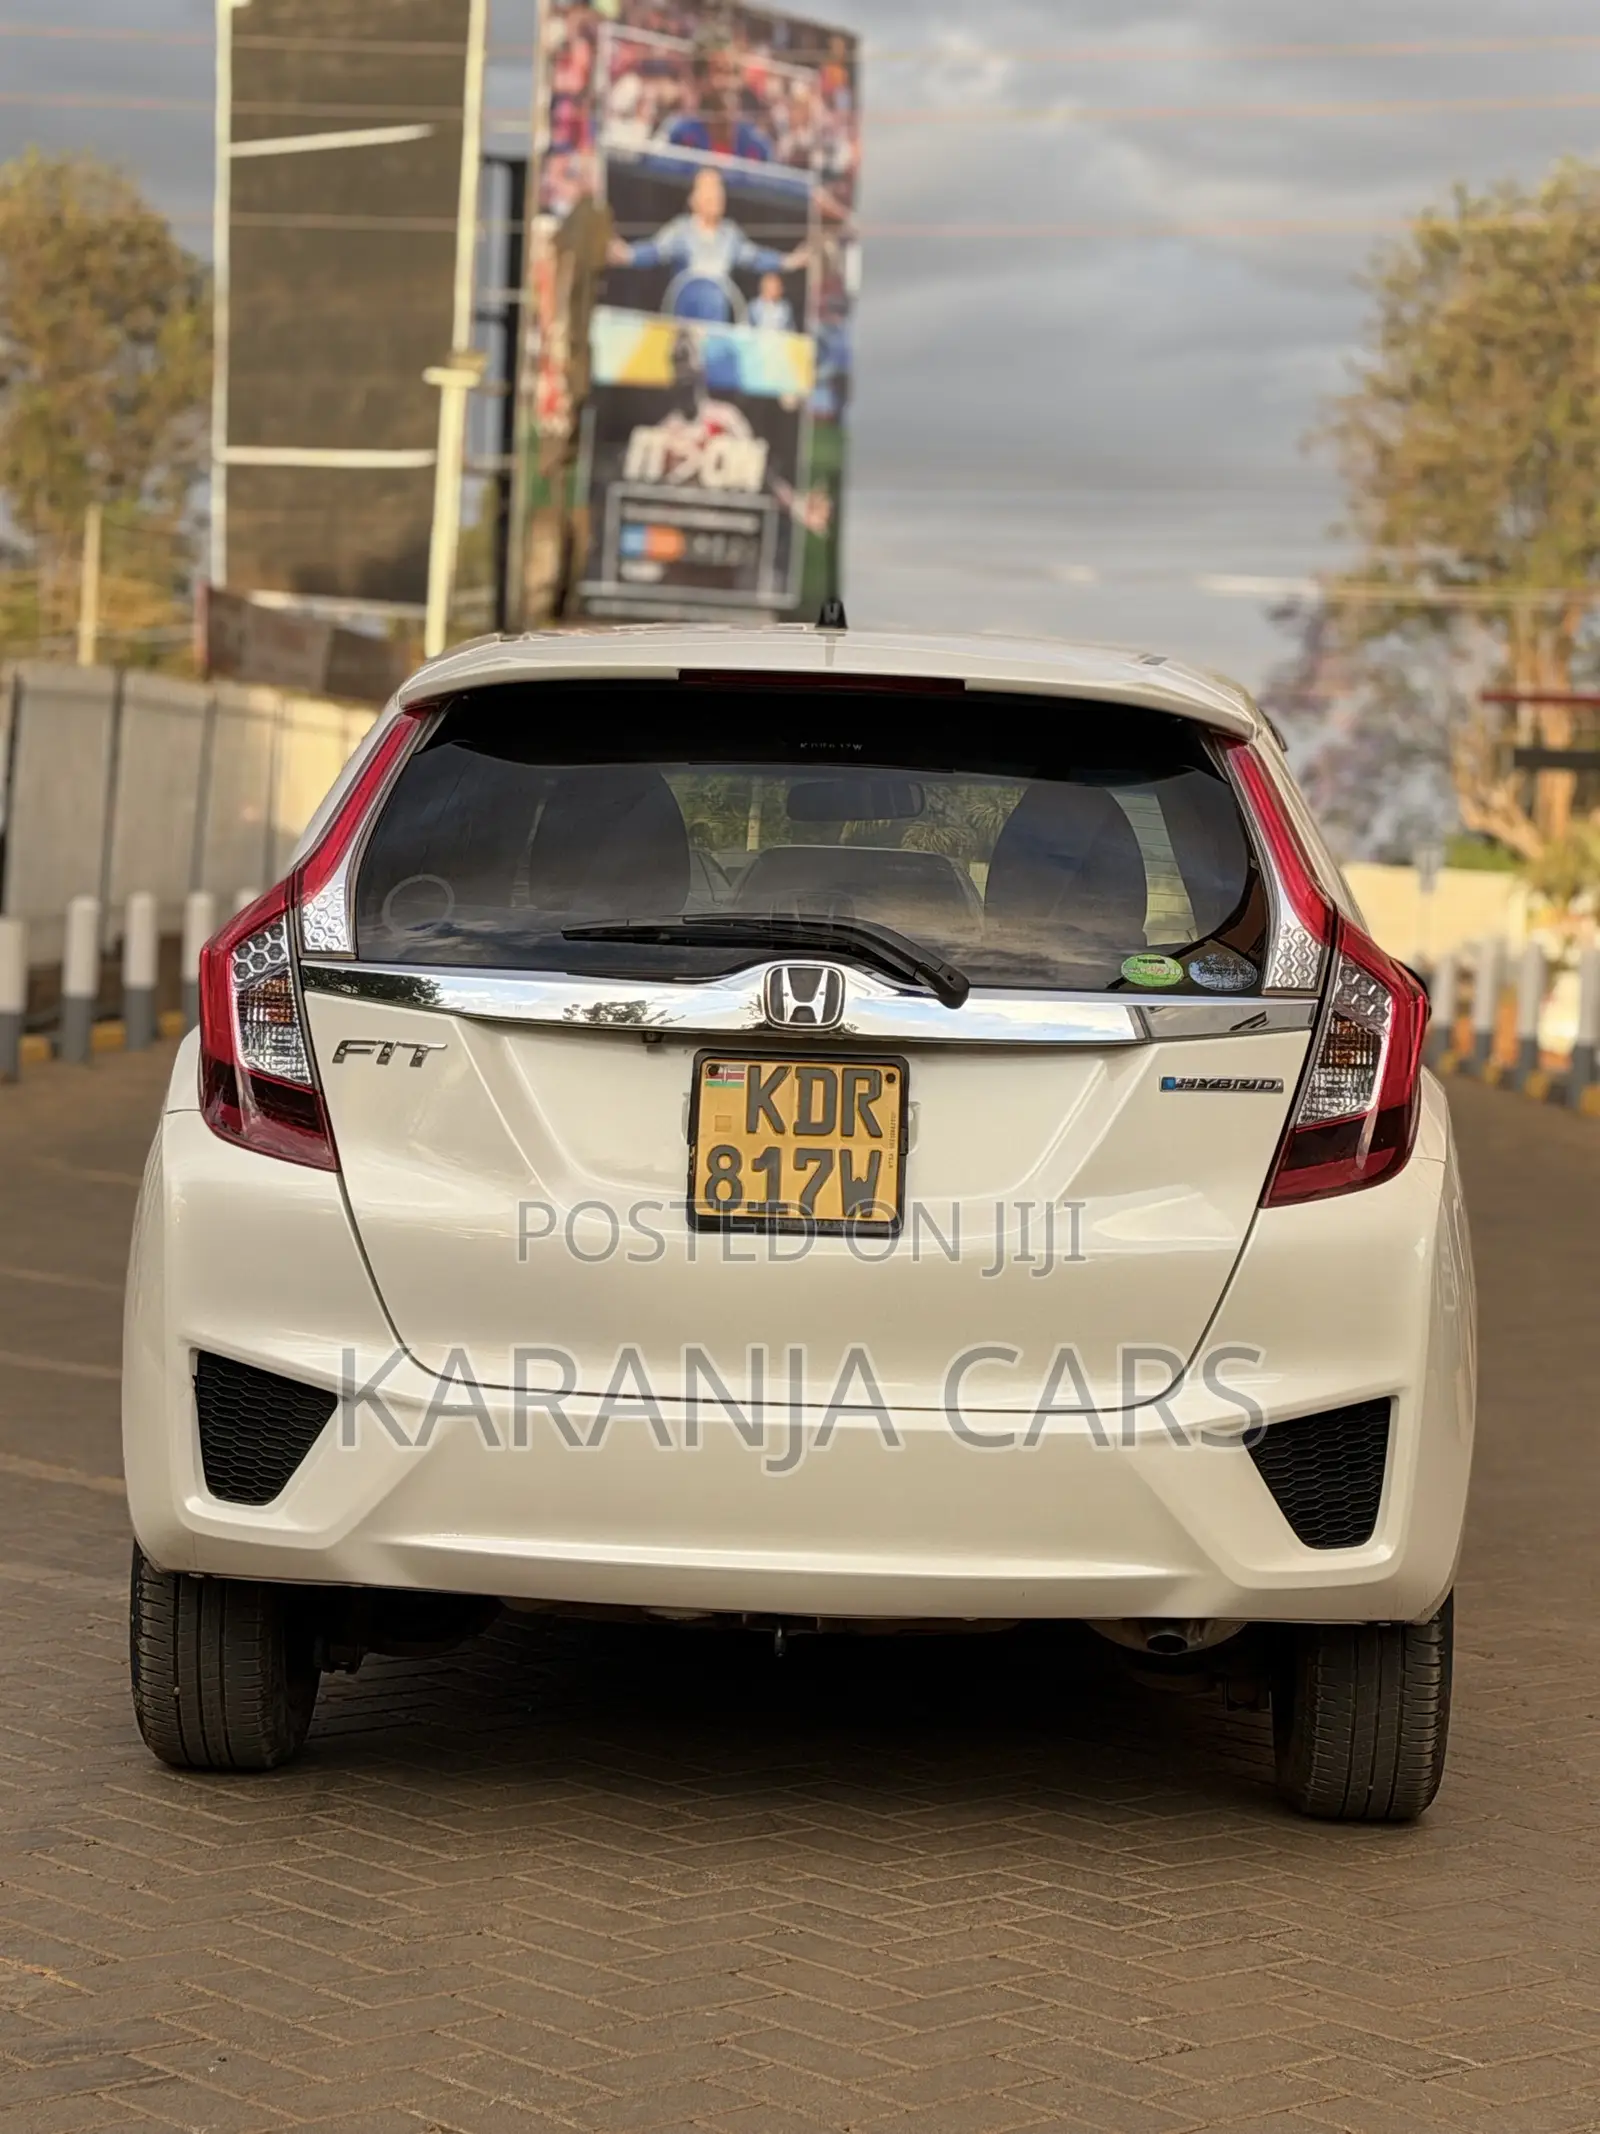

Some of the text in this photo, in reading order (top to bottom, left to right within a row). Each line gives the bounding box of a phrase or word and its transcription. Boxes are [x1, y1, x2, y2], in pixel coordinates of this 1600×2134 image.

[332, 1039, 448, 1068] FIT
[744, 1064, 884, 1139] KDR
[1176, 1077, 1278, 1091] HYBRID
[704, 1144, 883, 1219] 817W
